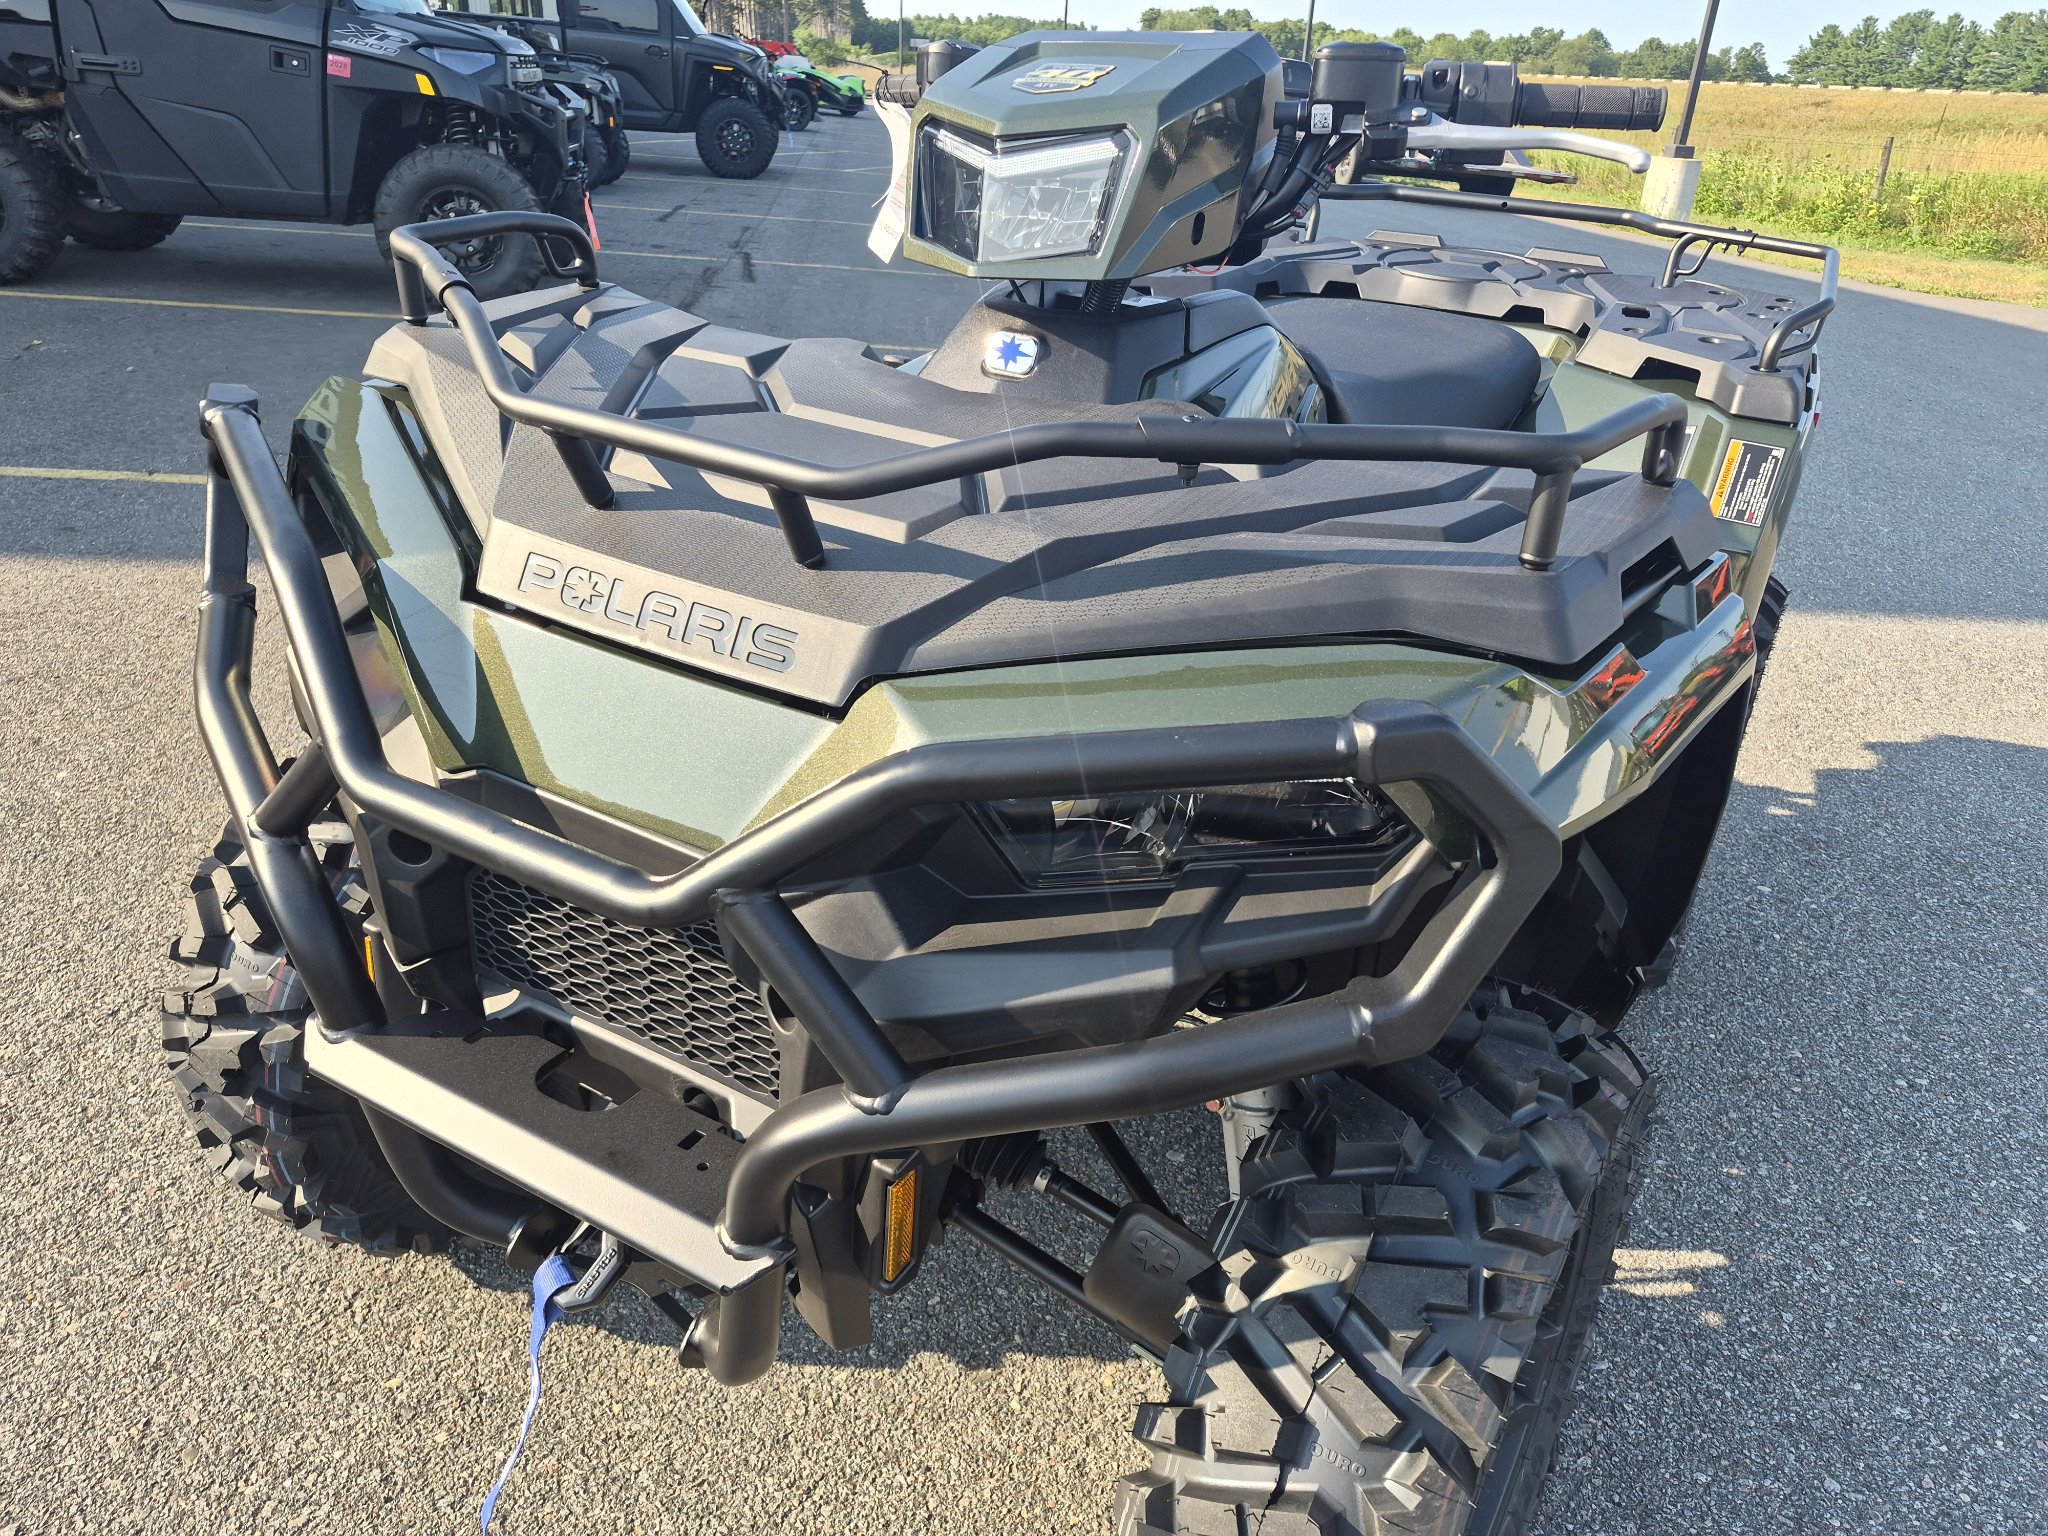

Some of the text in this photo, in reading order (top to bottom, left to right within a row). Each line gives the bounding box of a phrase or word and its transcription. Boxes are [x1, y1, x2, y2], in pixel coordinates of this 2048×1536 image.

[333, 23, 416, 46] XP
[342, 37, 400, 57] 1000
[1719, 457, 1735, 490] WARNING
[518, 551, 799, 673] POLARIS
[577, 1248, 617, 1299] POLARIS
[1291, 1252, 1342, 1281] DURO
[1308, 1441, 1367, 1477] DURO
